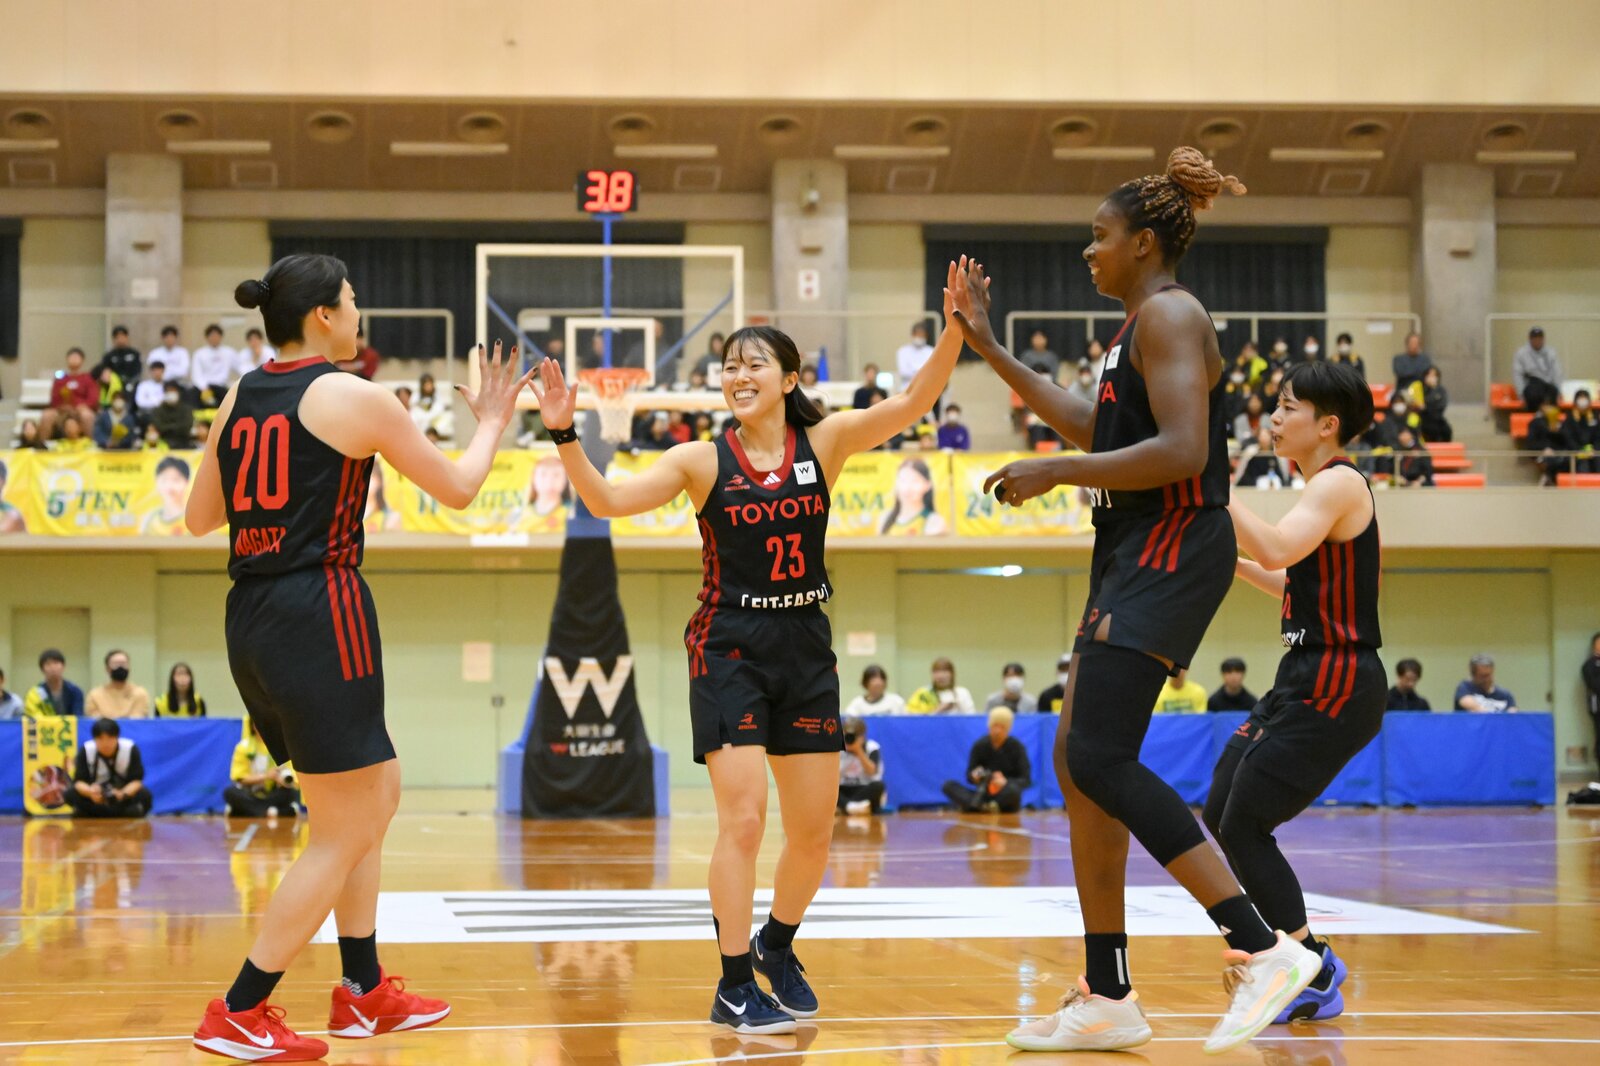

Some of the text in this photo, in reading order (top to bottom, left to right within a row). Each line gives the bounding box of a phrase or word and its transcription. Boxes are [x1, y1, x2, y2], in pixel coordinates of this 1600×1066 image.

[231, 413, 290, 512] 20
[799, 466, 809, 474] W
[78, 490, 131, 510] TEN
[724, 494, 825, 526] TOYOTA
[766, 533, 806, 581] 23
[545, 656, 634, 719] W
[569, 740, 625, 757] LEAGUE
